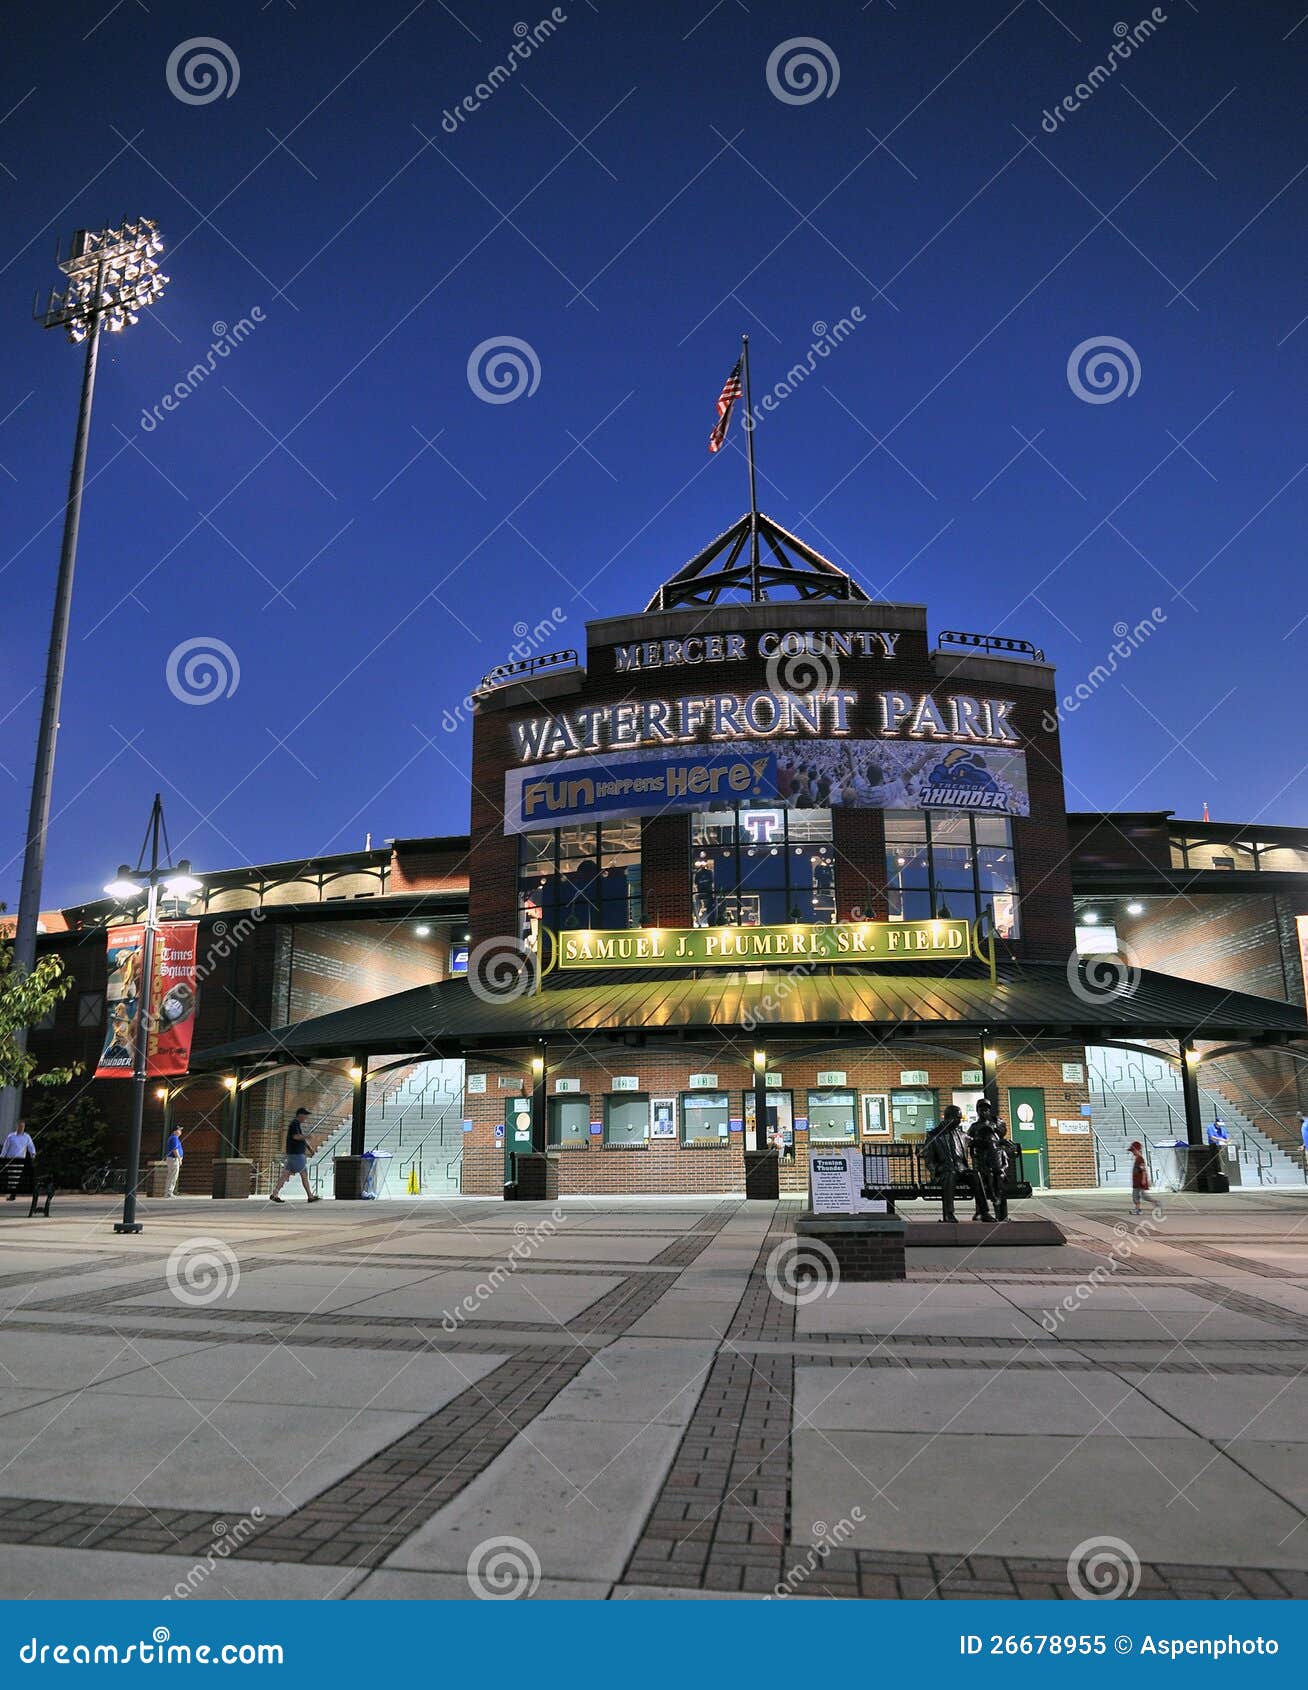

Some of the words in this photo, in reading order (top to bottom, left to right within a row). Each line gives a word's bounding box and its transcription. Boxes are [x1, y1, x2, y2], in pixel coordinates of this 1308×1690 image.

[613, 633, 748, 672] MERCER
[758, 630, 901, 660] COUNTY
[508, 688, 859, 762] WATERFRONT
[878, 689, 1021, 744] PARK
[524, 777, 595, 815] Fun
[920, 786, 1006, 809] THUNDER
[161, 947, 193, 961] Times
[566, 935, 665, 961] SAMUEL
[675, 938, 694, 957] J.
[705, 932, 827, 958] PLUMERI,
[837, 931, 876, 954] SR.
[887, 927, 963, 951] FIELD
